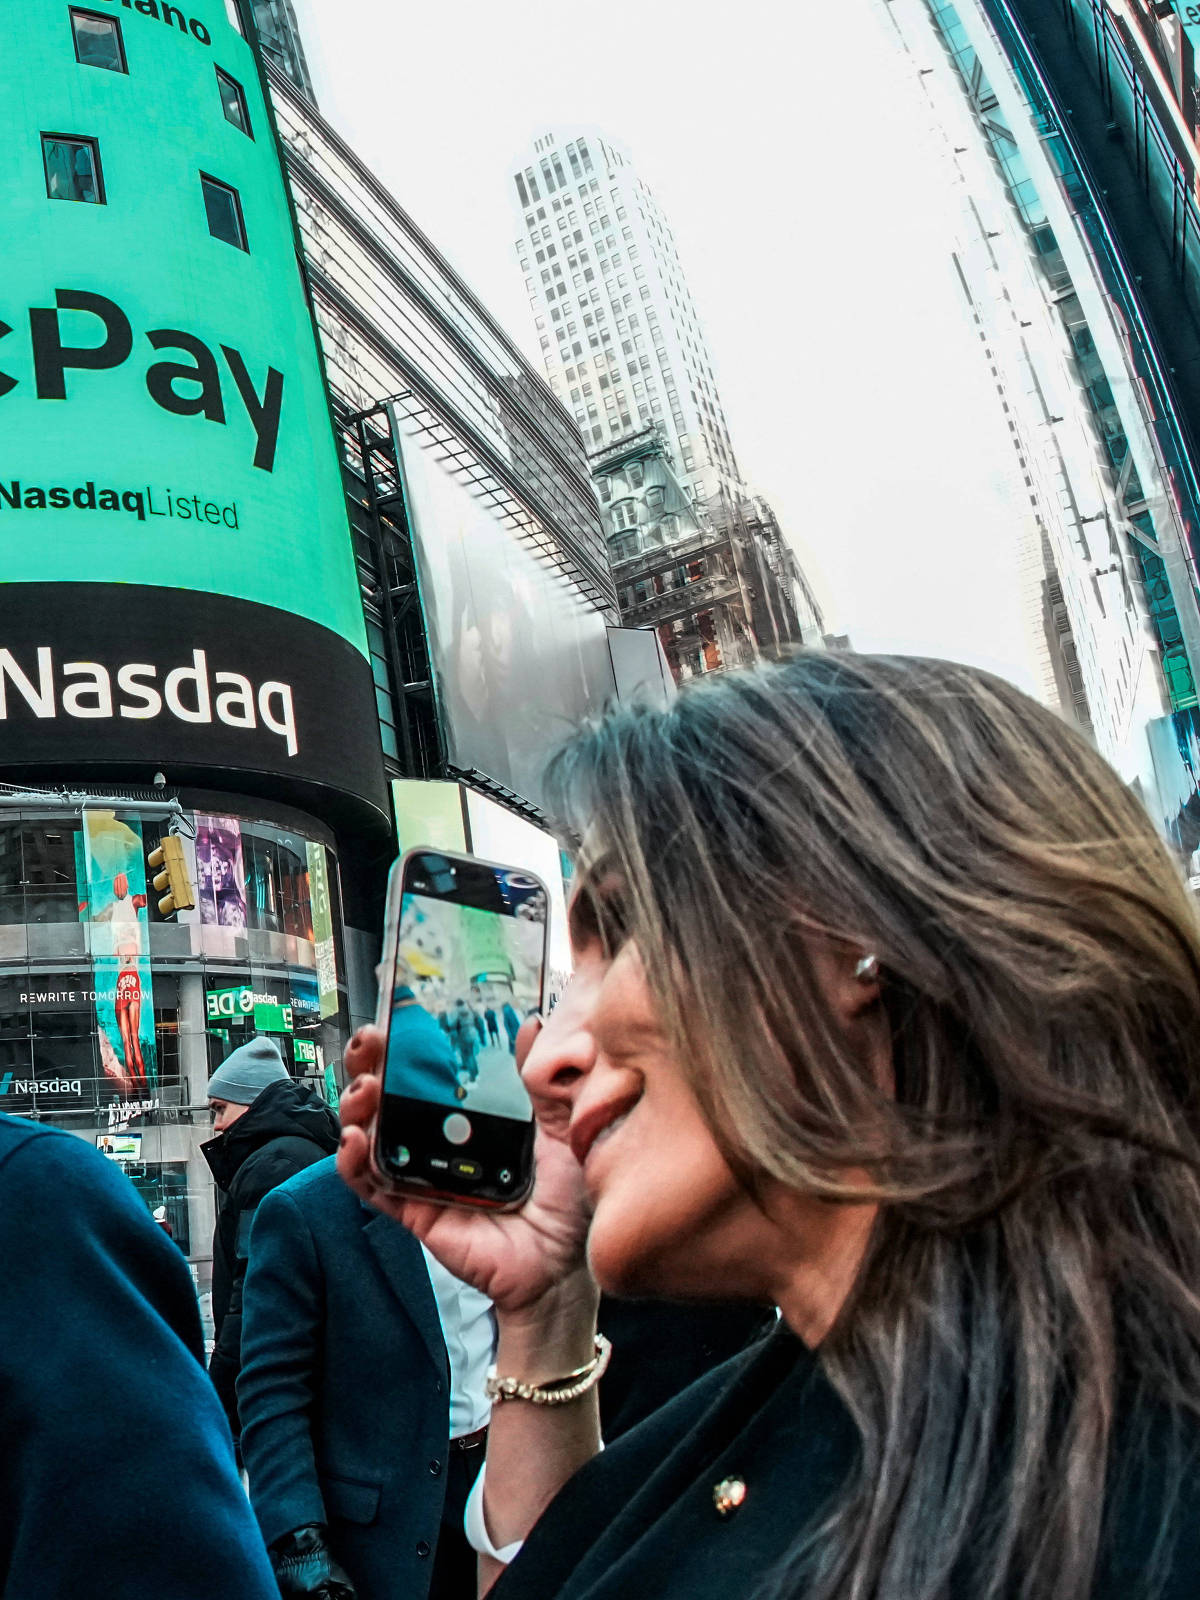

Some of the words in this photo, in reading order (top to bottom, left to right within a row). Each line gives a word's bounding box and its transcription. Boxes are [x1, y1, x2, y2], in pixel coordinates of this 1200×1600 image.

[103, 0, 212, 46] ano
[19, 991, 76, 1003] REWRITE
[81, 990, 152, 1001] TOMORROW
[14, 1077, 82, 1095] Nasdaq
